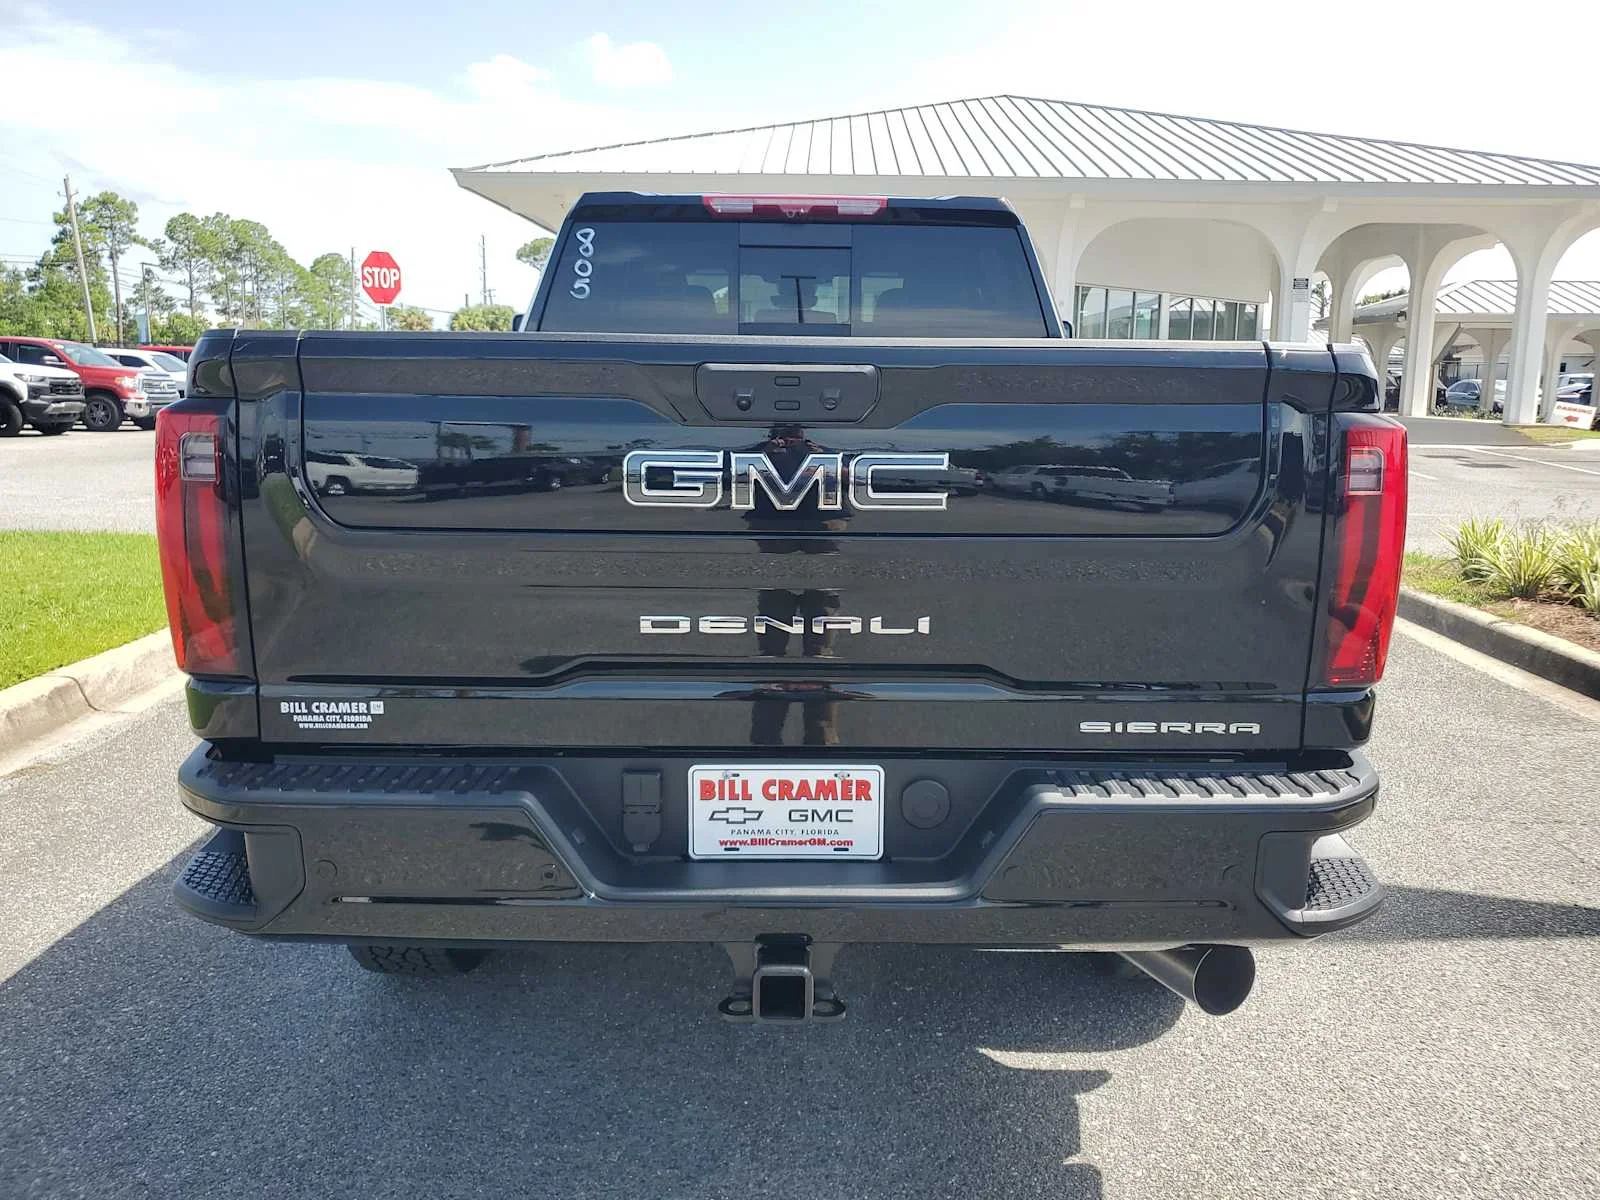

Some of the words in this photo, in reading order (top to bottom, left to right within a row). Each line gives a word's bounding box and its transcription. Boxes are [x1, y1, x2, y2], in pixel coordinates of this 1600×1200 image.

[570, 228, 596, 299] 805
[362, 265, 400, 289] STOP
[622, 449, 950, 511] GMC
[639, 615, 931, 635] DENALI
[280, 701, 308, 714] BILL
[311, 701, 369, 714] CRAMER
[293, 714, 325, 723] PANAMA
[343, 714, 373, 723] FLORIDA
[1079, 721, 1261, 735] SIERRA
[699, 779, 753, 801] BILL
[761, 779, 873, 802] CRAMER
[788, 809, 854, 823] GMC
[730, 828, 771, 836] PANAMA
[801, 828, 840, 836] FLORIDA
